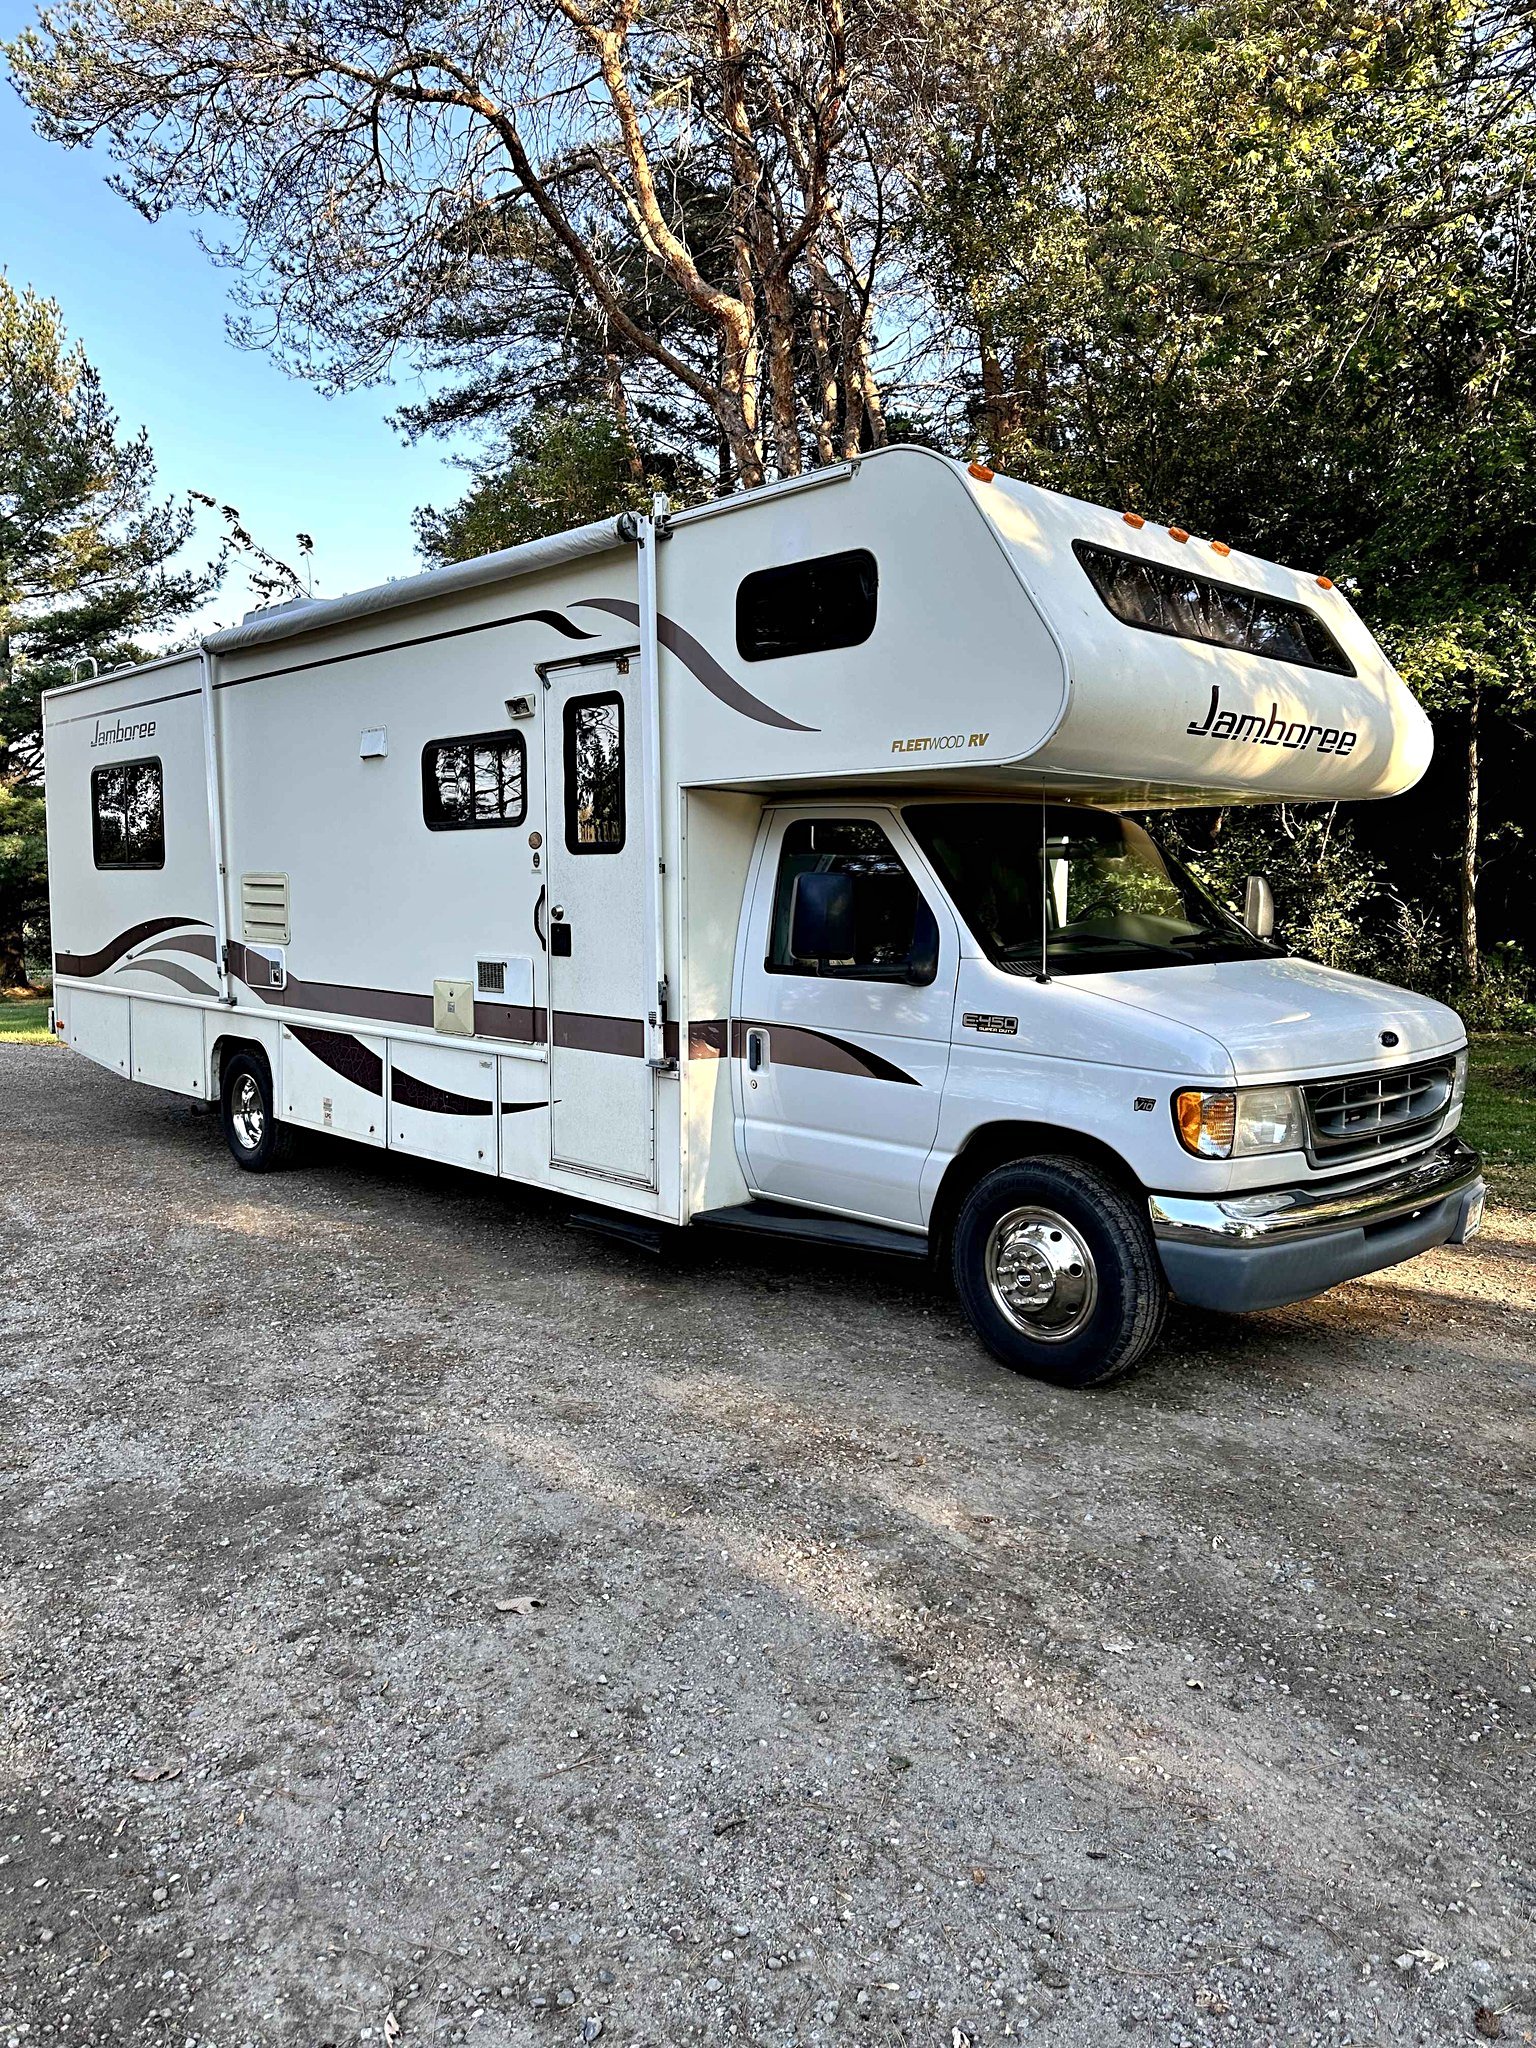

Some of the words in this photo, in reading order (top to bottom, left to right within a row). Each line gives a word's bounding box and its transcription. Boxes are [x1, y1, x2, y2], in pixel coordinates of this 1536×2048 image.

[1187, 685, 1357, 755] Jamboree
[90, 719, 156, 748] Jamboree
[892, 735, 965, 753] FLEETWOOD
[968, 733, 989, 747] RV
[1135, 1100, 1153, 1110] V10
